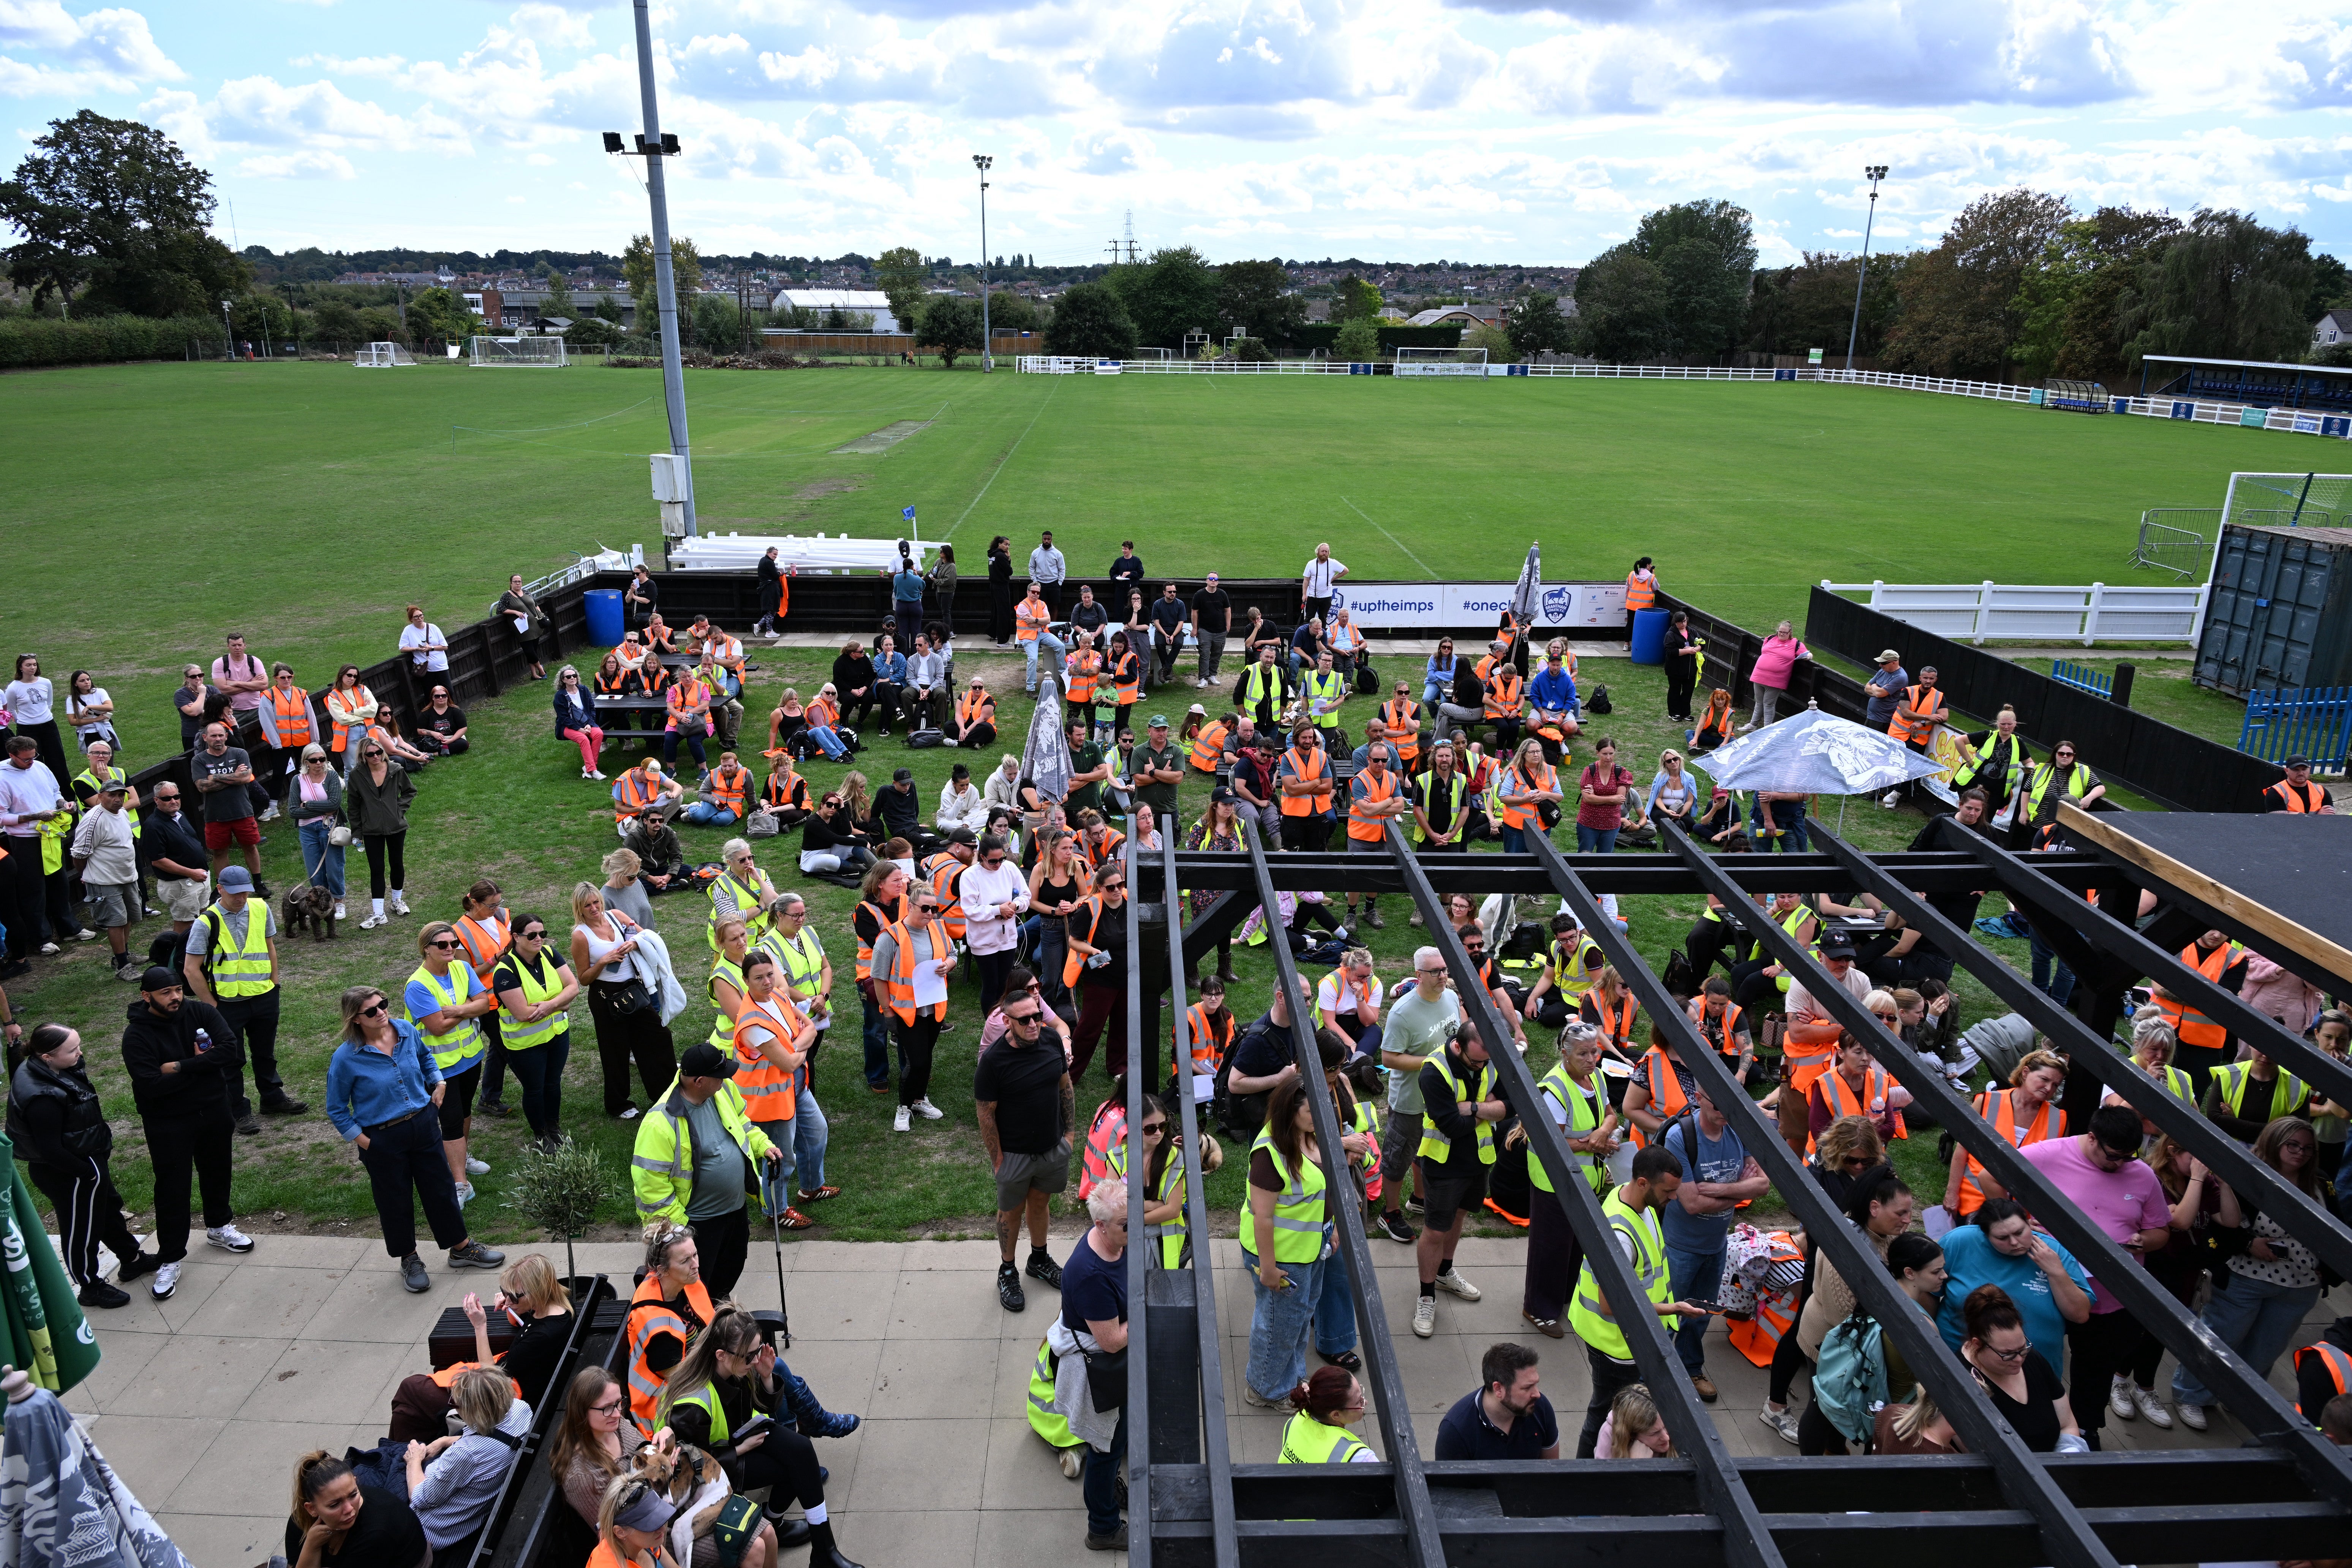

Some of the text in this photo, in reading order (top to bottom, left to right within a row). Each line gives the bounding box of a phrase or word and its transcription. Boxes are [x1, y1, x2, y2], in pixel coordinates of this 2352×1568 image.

[1351, 599, 1434, 613] #uptheimps
[1463, 600, 1511, 611] #onecl
[1923, 778, 1934, 787] BOUNCY
[1428, 1013, 1457, 1037] SAN DIEGO
